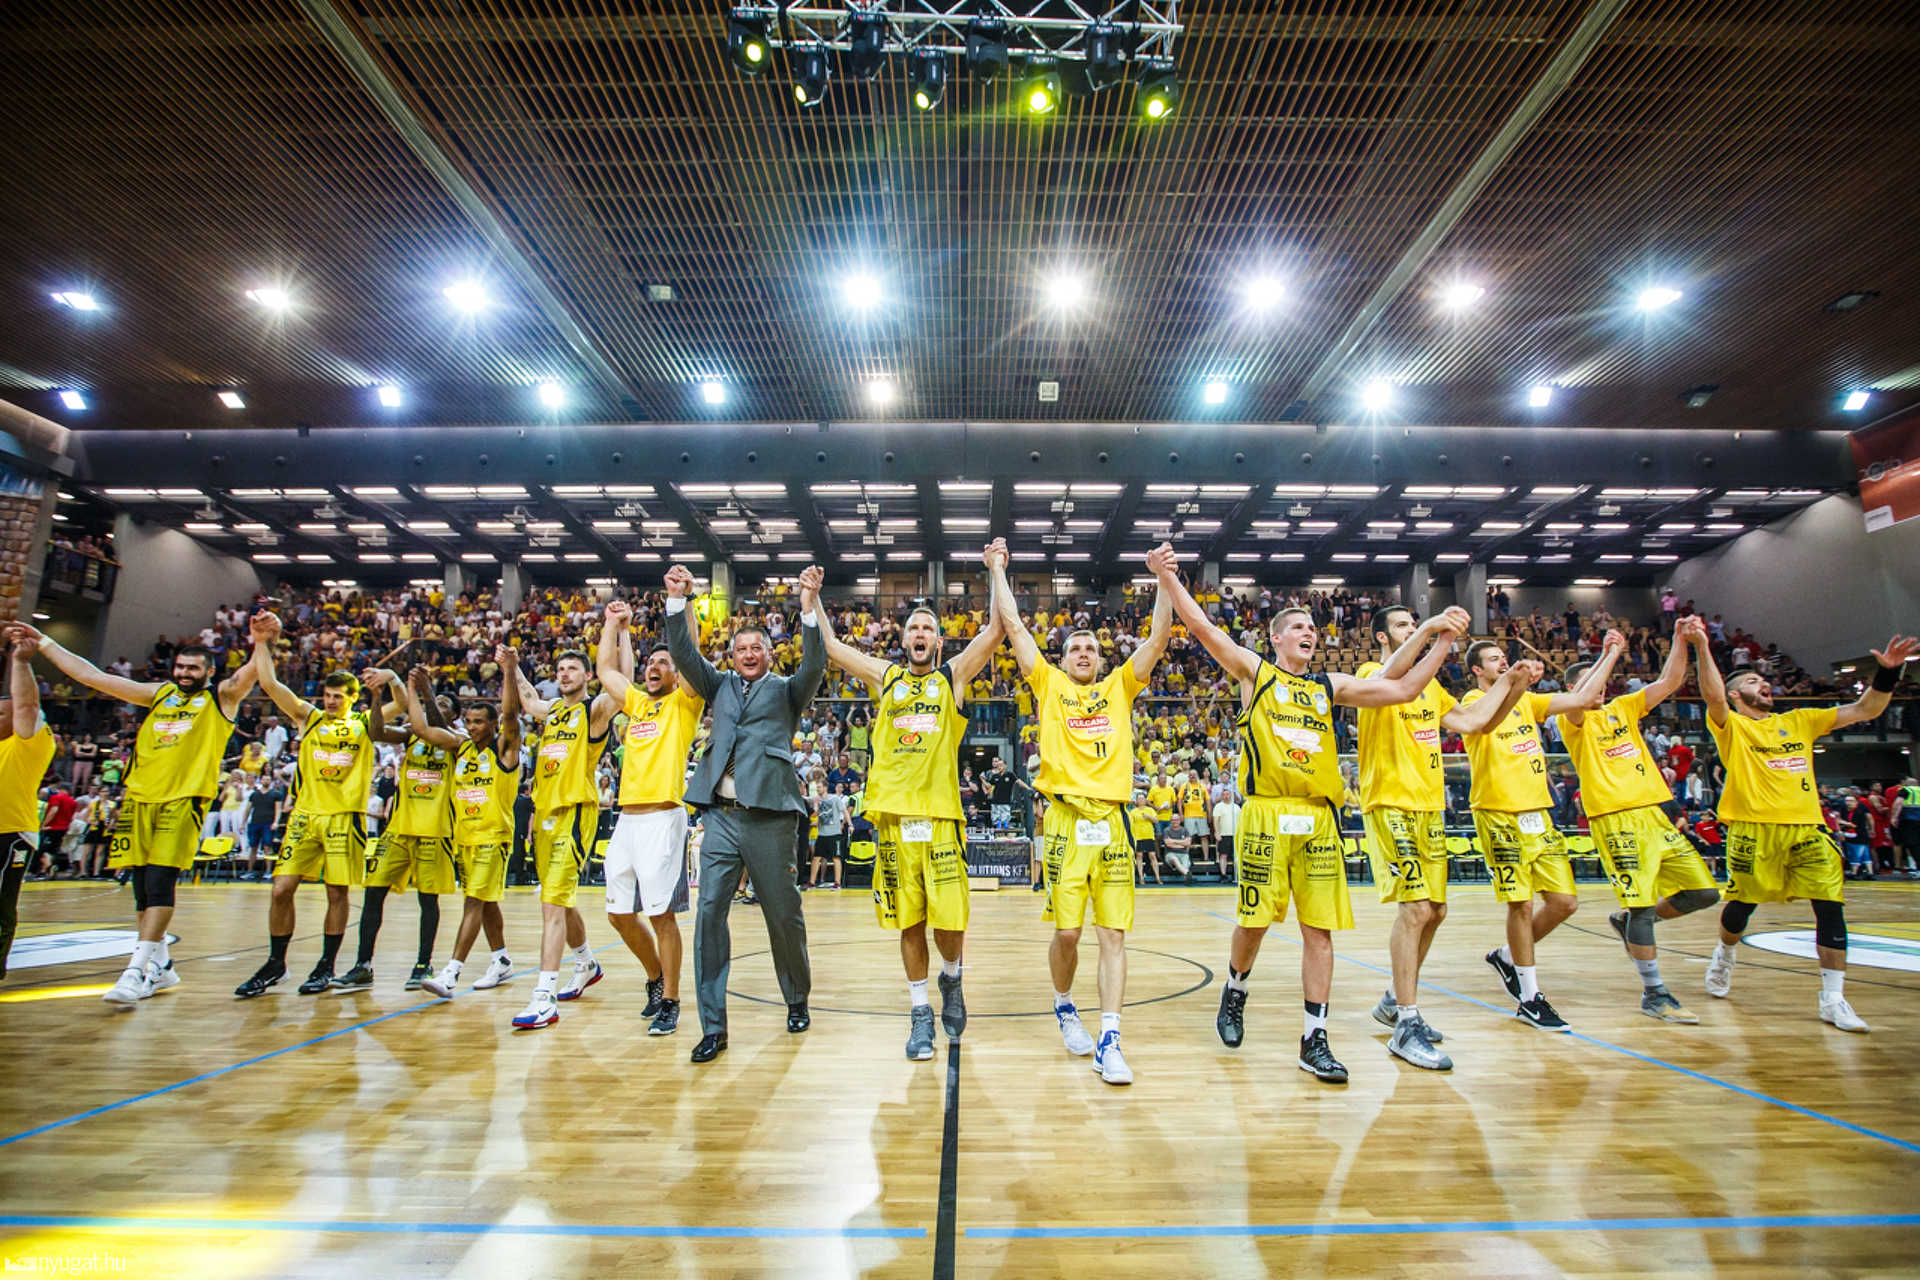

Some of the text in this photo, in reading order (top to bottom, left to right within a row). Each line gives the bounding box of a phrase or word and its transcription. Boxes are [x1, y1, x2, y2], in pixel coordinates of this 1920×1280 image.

[1293, 690, 1312, 706] 10
[551, 711, 571, 726] 34
[1095, 741, 1106, 758] 11
[1430, 753, 1440, 769] 21
[1530, 759, 1544, 775] 12
[1635, 763, 1645, 776] 9
[1801, 777, 1810, 791] 6
[111, 837, 130, 852] 30
[1243, 842, 1272, 857] FLAG
[1402, 860, 1422, 881] 21
[1496, 866, 1516, 884] 12
[1619, 873, 1632, 890] 9
[1240, 884, 1259, 907] 10
